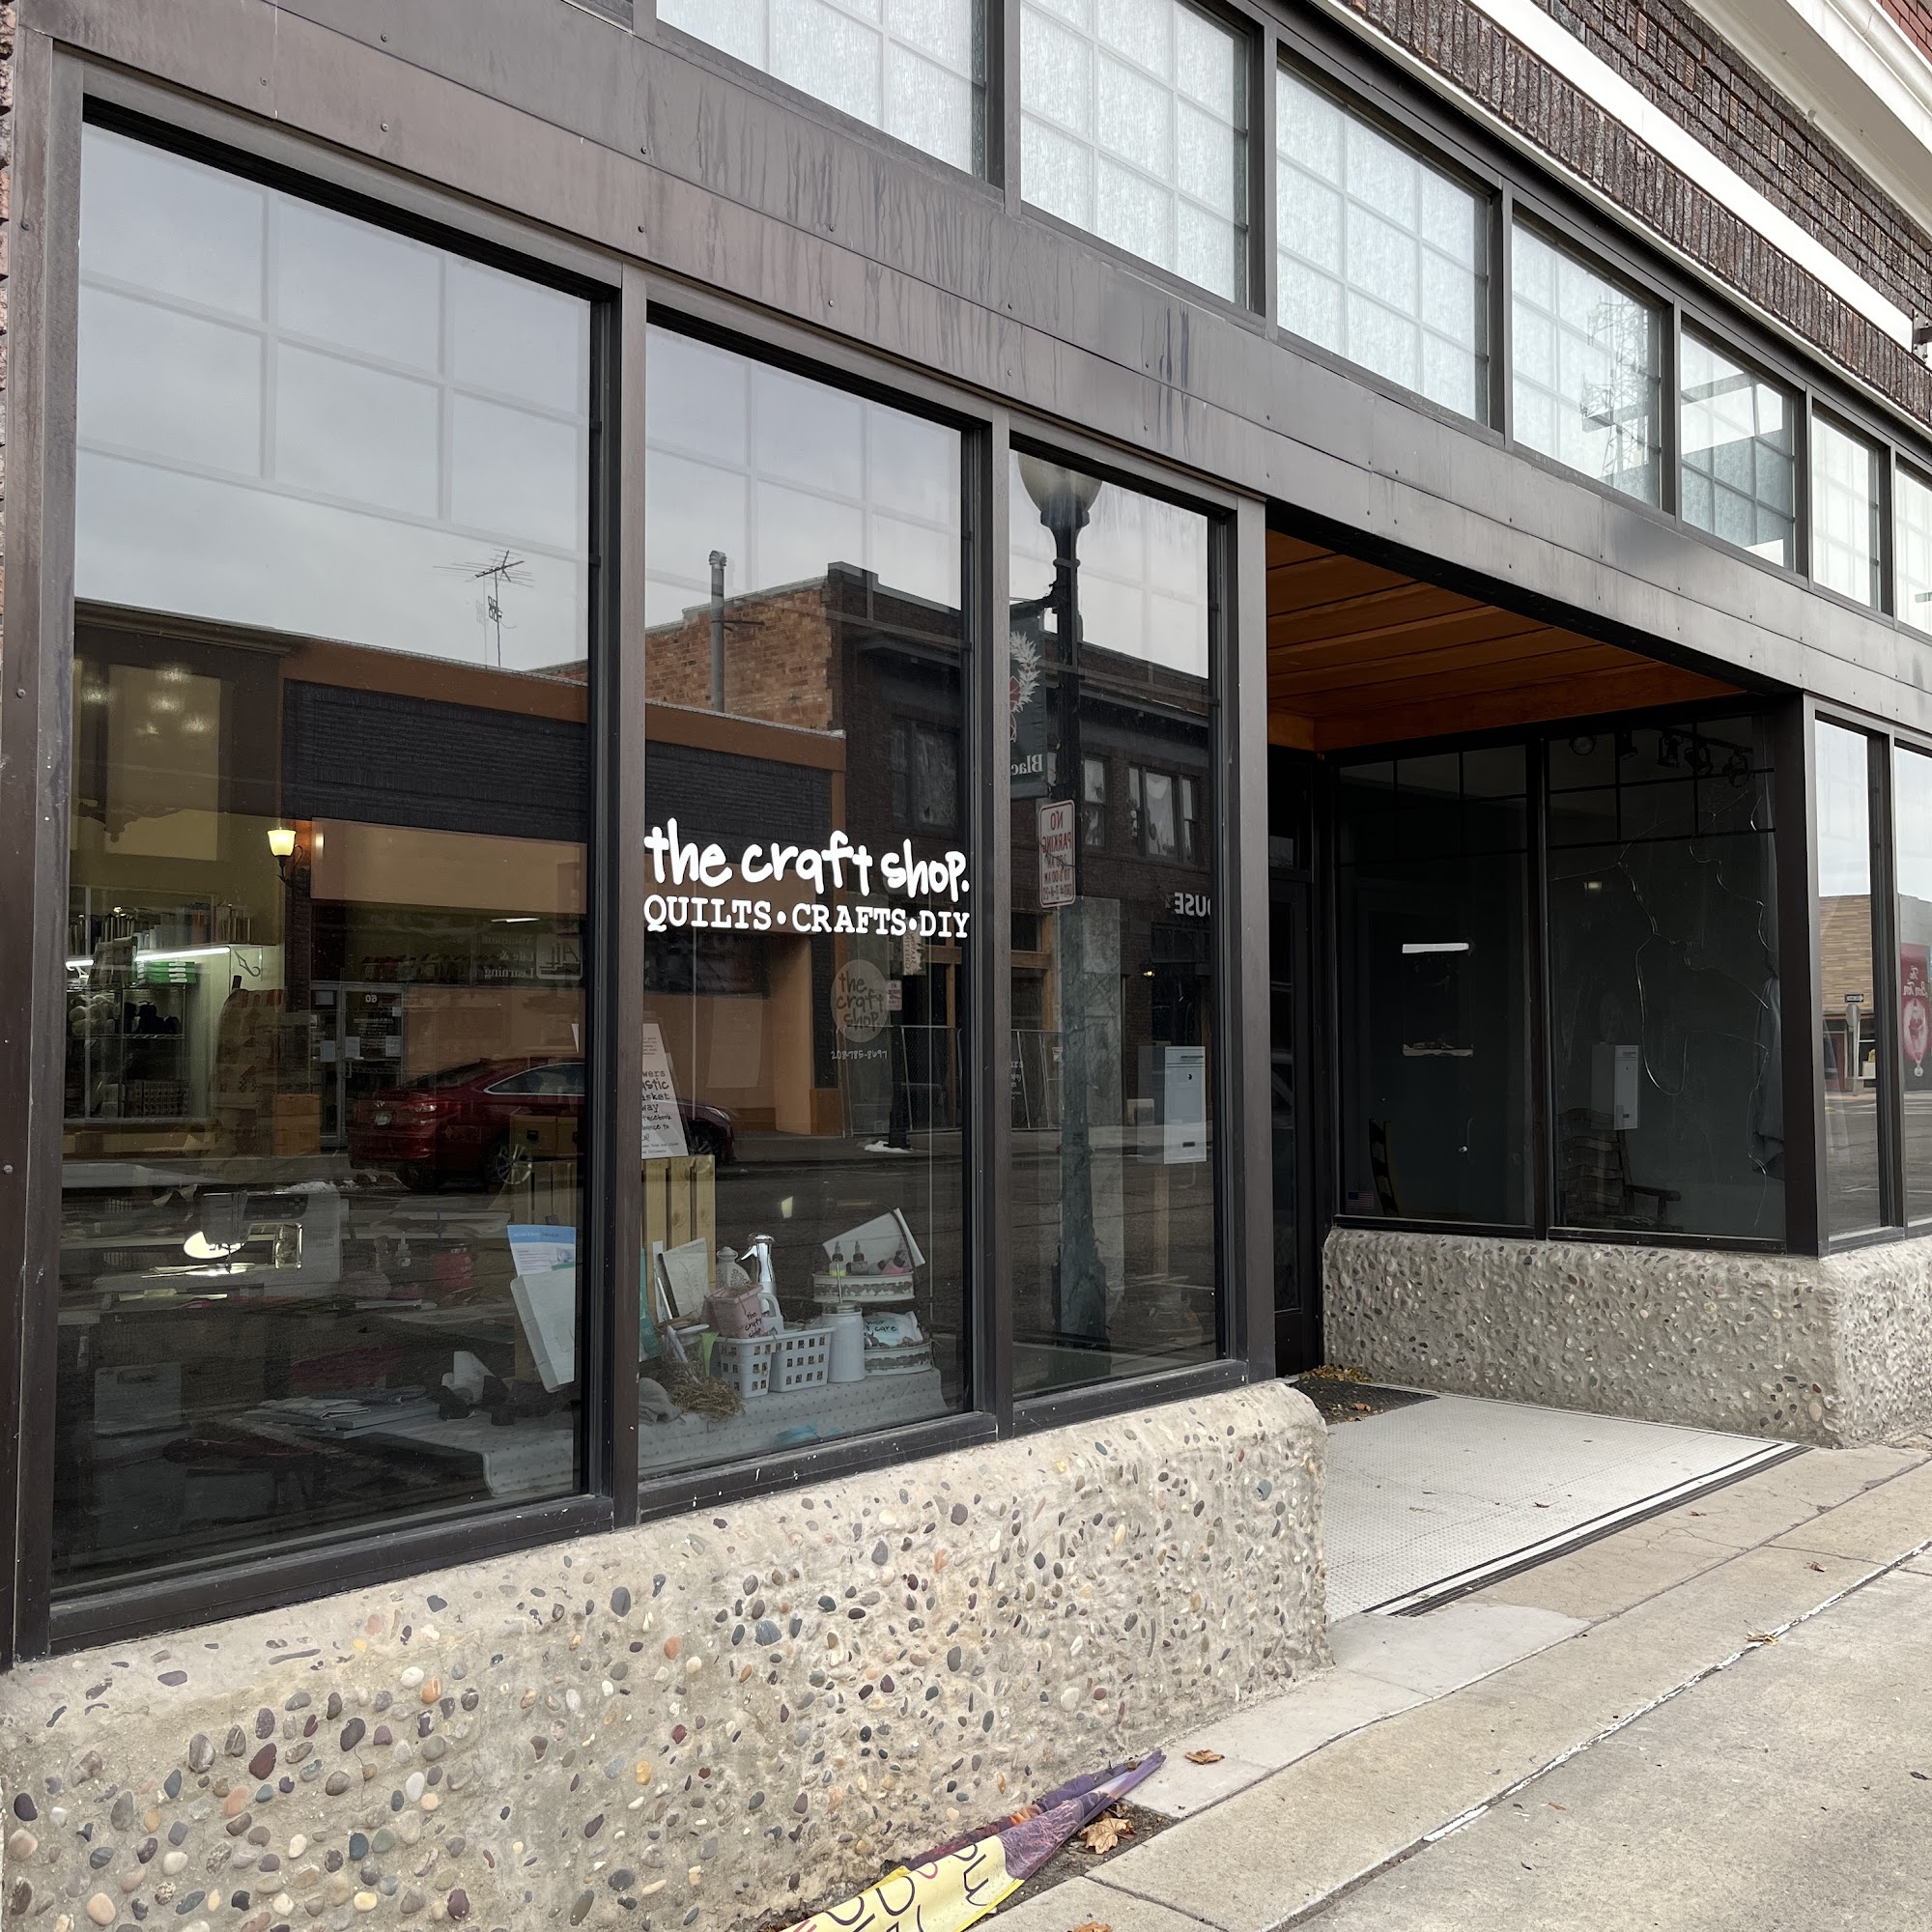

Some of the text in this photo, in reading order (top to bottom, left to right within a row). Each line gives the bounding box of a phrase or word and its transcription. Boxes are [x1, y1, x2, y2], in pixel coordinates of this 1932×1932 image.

[643, 817, 970, 902] the craft shop.
[643, 894, 970, 938] QUILTS CRAFTS DIY
[838, 970, 867, 993] the
[836, 988, 884, 1013] craft
